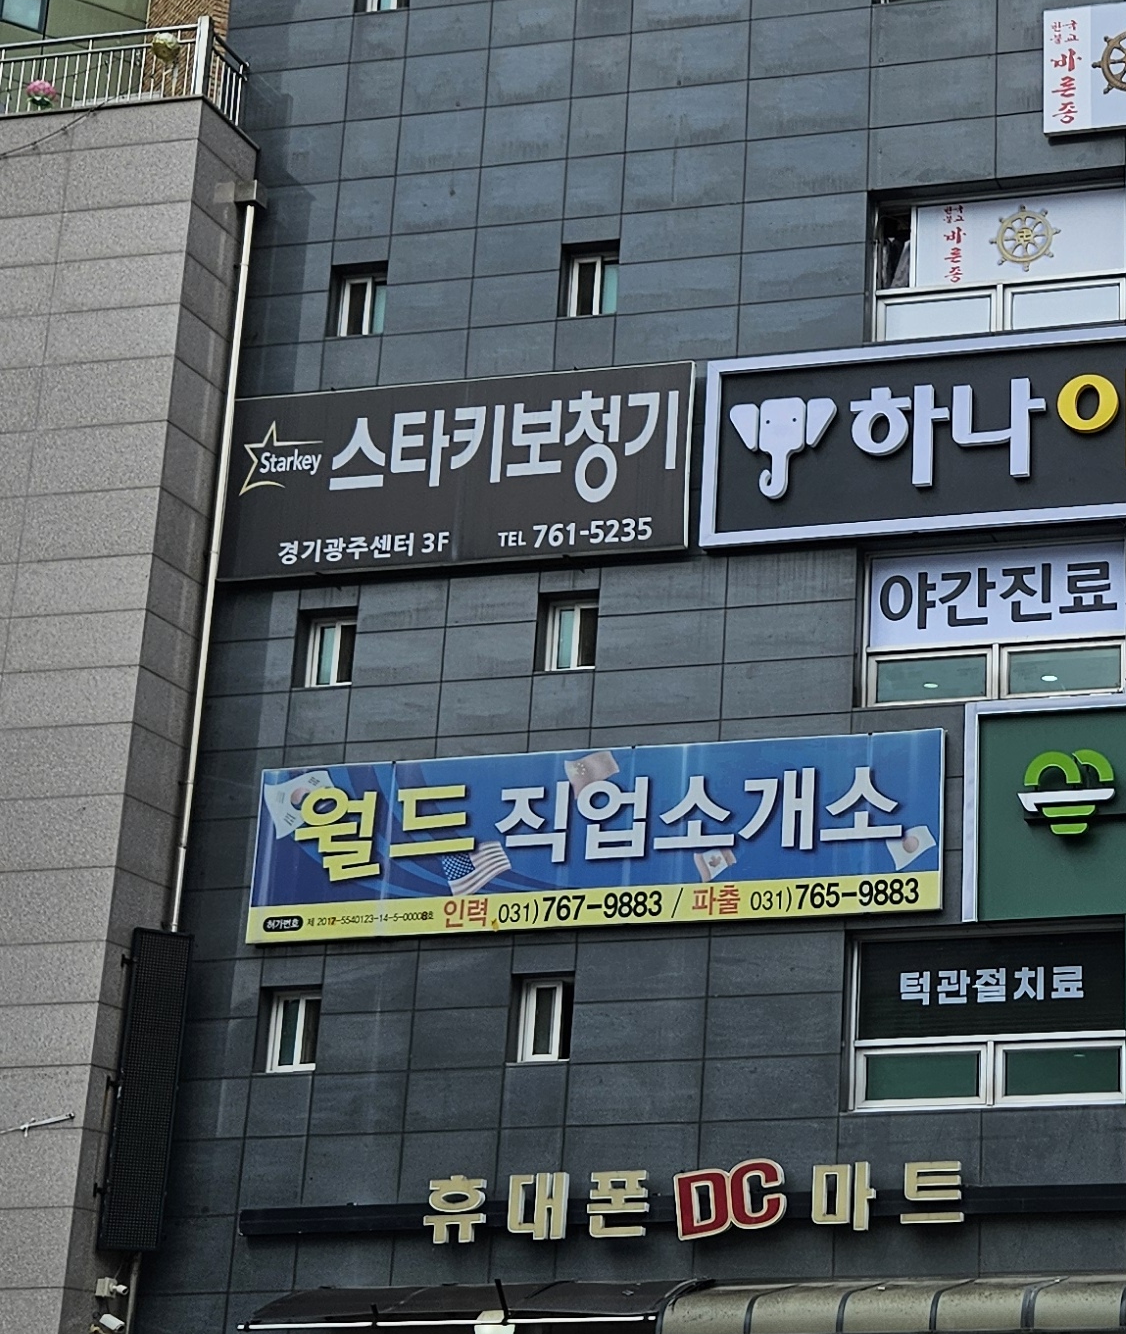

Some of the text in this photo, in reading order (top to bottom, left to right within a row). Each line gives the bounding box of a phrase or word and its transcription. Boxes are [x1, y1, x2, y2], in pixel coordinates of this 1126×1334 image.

[1050, 48, 1083, 124] 바른종
[260, 389, 681, 503] Starkey 스타키보청기
[278, 516, 653, 565] 경기광주센터 3F TEL 761-5235
[879, 558, 1119, 630] 야간진료
[295, 765, 904, 883] 월드 직업소개소
[265, 918, 301, 930] 허가번호
[443, 898, 489, 929] 인력
[691, 884, 742, 916] 파출
[899, 964, 1085, 1007] 턱관절치료
[422, 1169, 651, 1245] 휴대폰
[672, 1157, 787, 1242] DC
